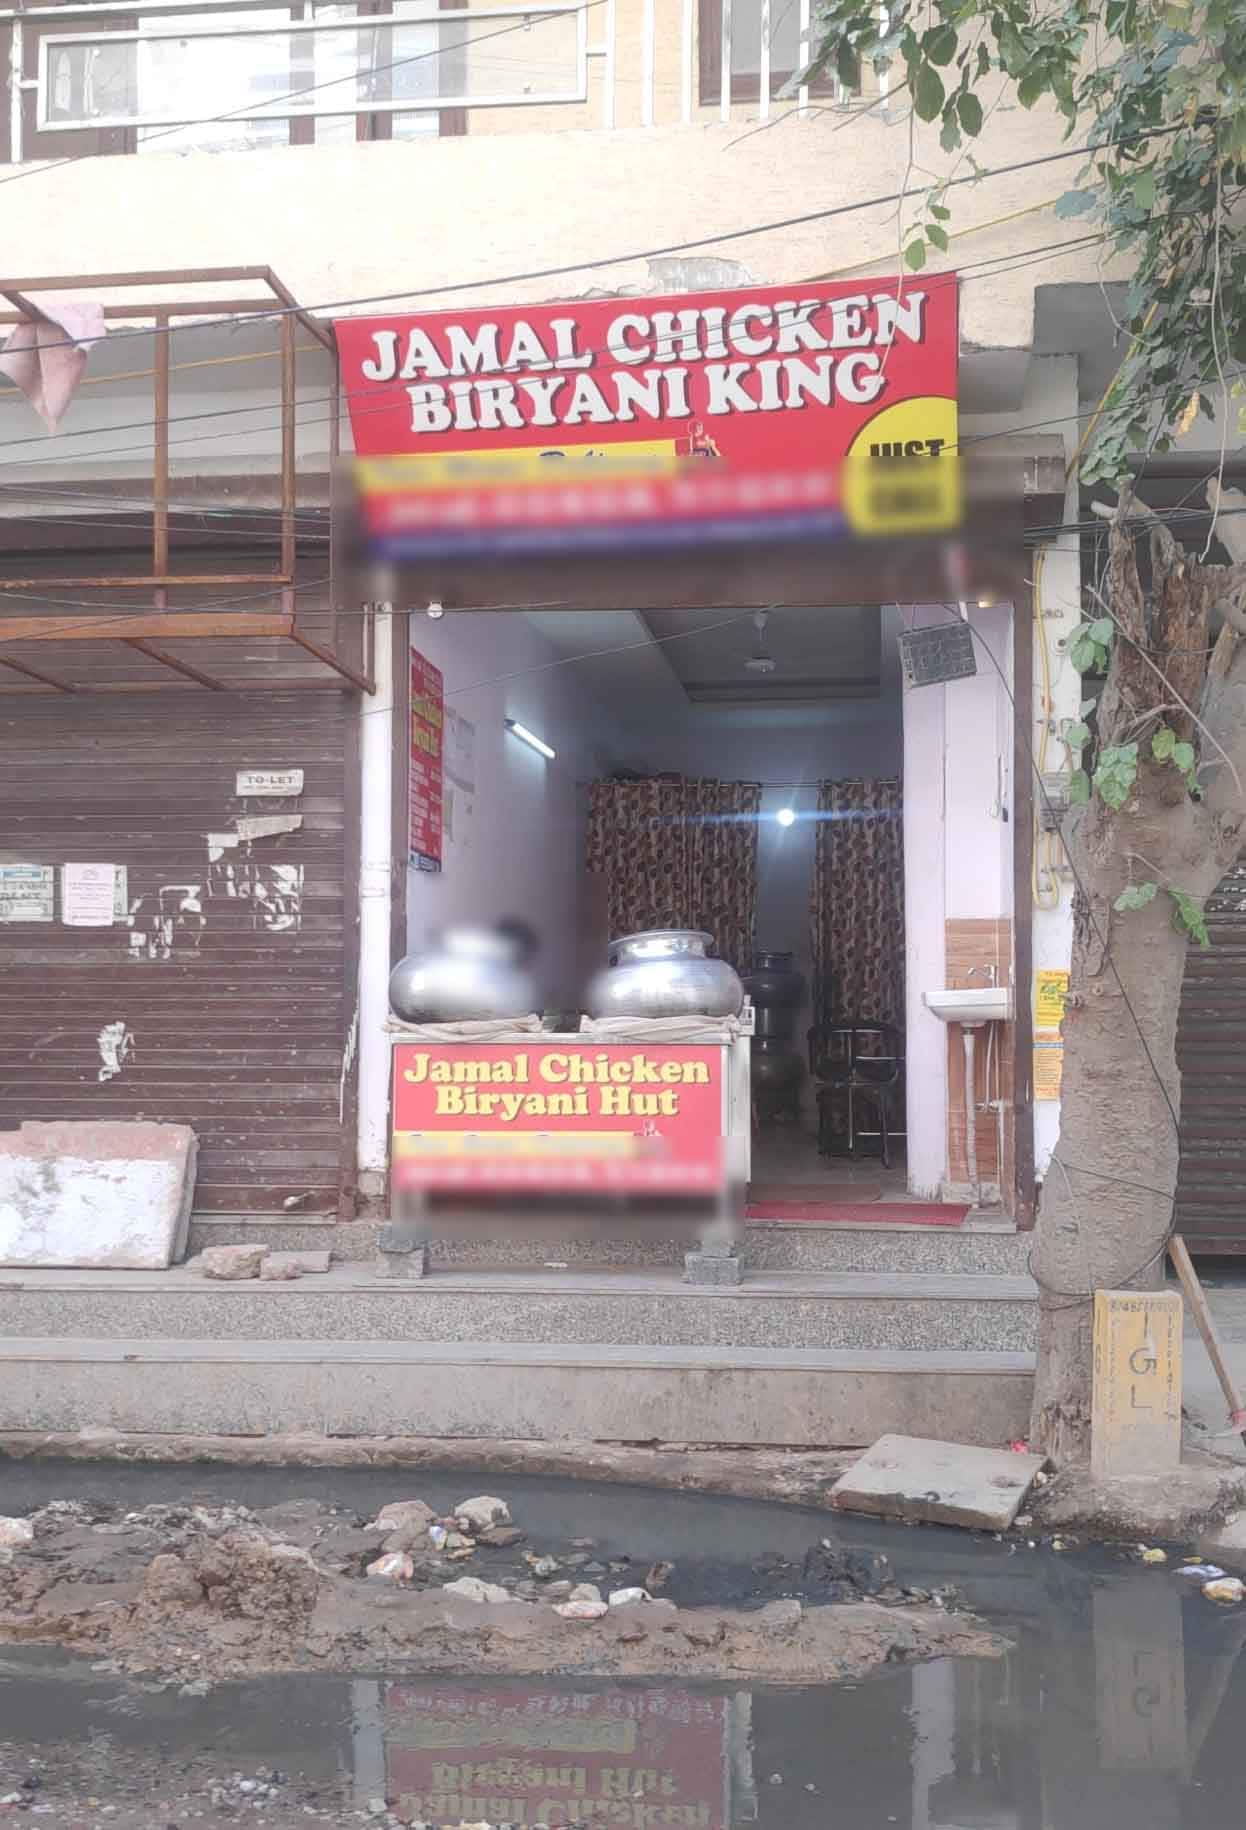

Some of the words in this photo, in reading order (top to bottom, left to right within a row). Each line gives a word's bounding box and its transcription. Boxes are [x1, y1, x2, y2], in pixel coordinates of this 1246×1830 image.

[362, 318, 594, 381] JAMAL
[607, 292, 925, 365] CHICKEN
[405, 368, 690, 432] BIRYANI
[704, 352, 886, 415] KING
[403, 1053, 529, 1083] Jamal
[539, 1053, 710, 1083] Chicken
[435, 1086, 589, 1121] Biryani
[600, 1086, 680, 1116] Hut
